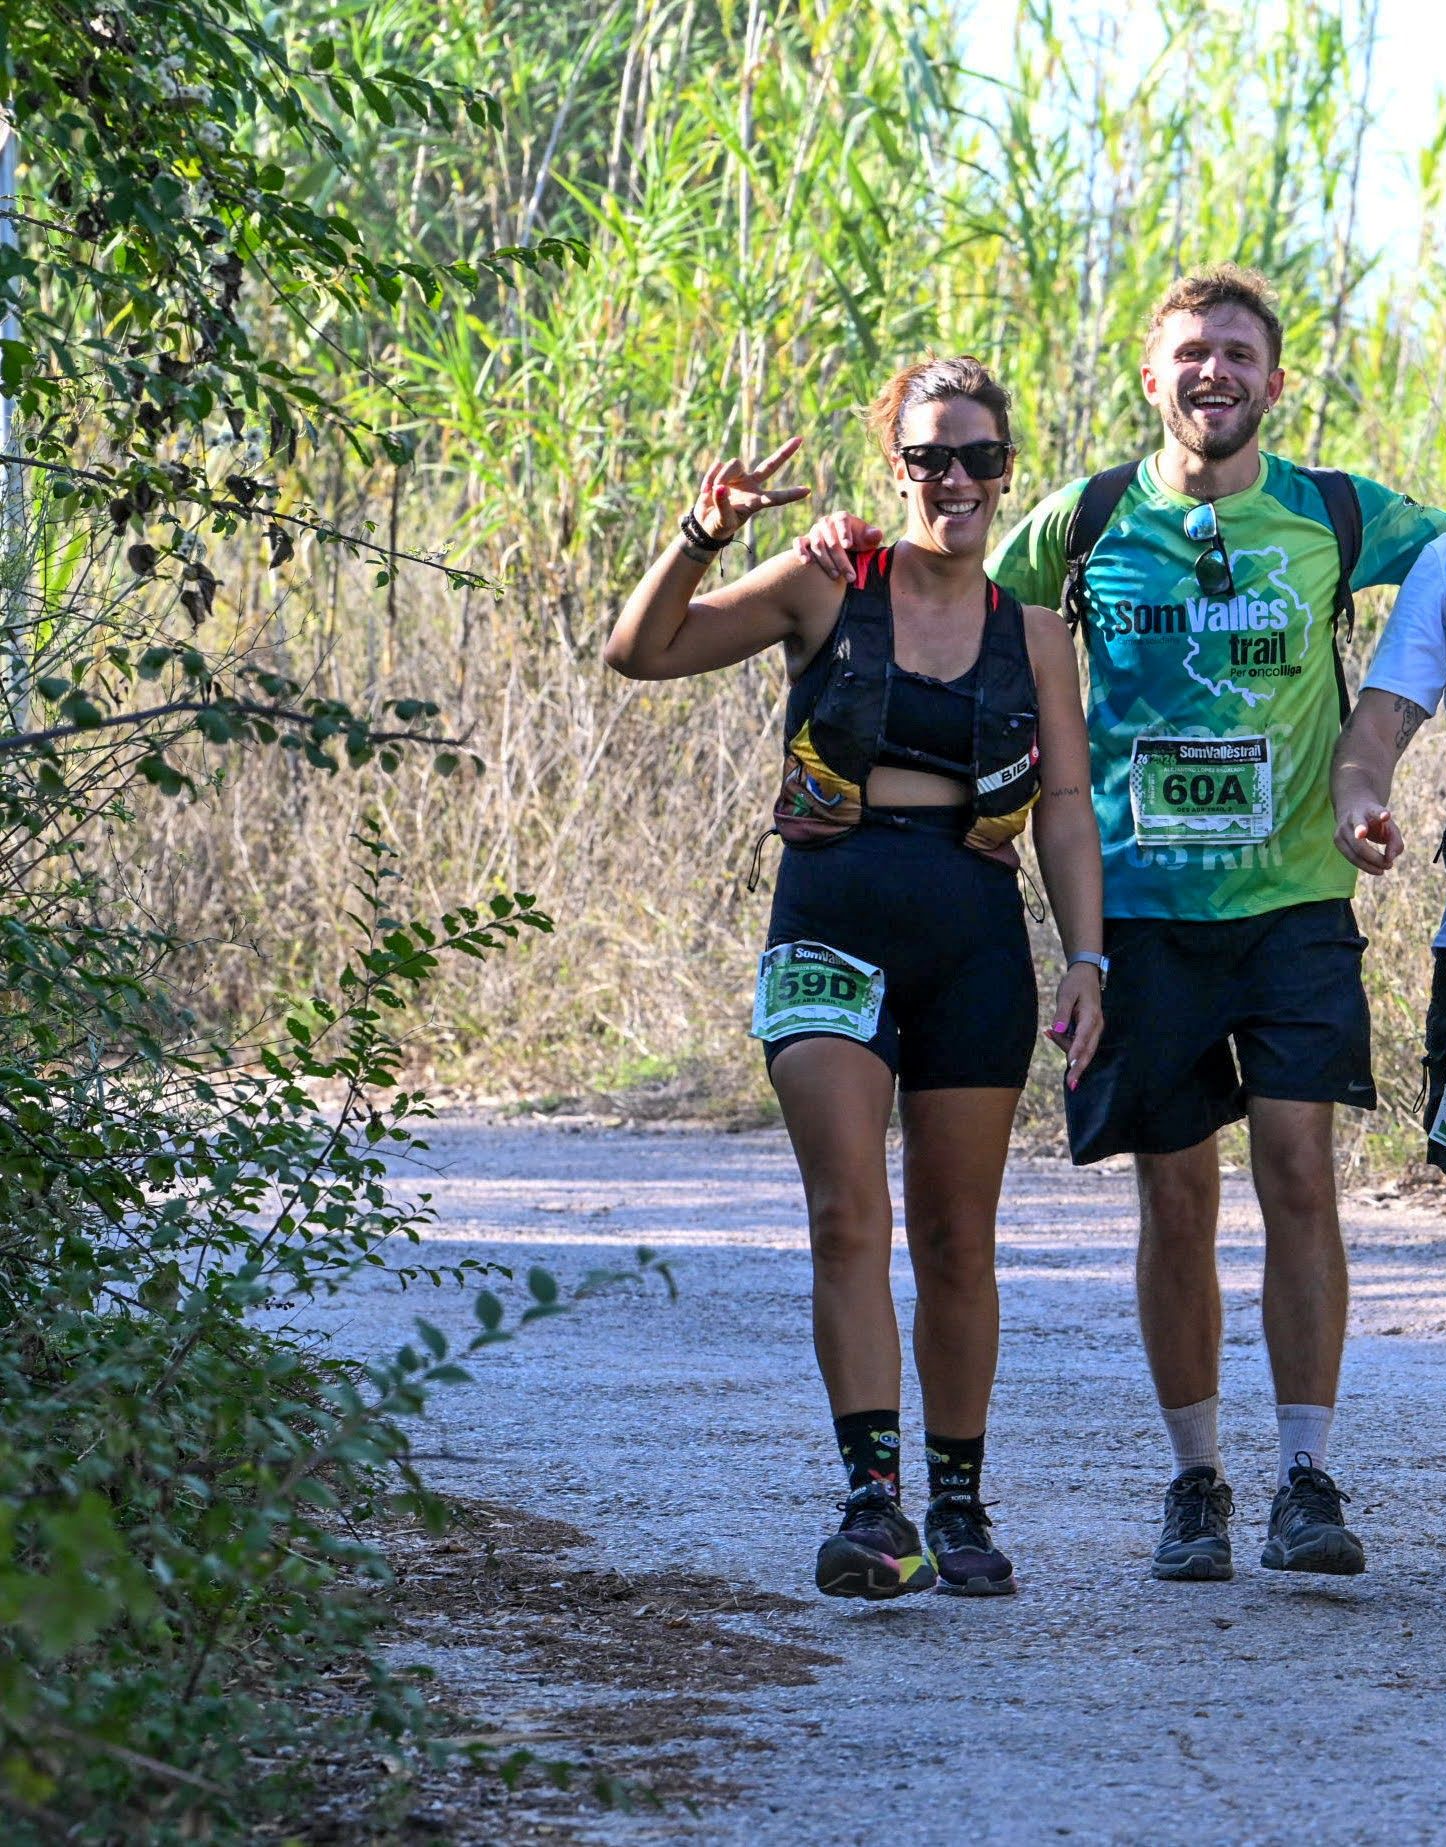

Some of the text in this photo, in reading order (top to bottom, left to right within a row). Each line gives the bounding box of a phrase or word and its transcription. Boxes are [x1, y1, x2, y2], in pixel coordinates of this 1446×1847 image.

[1229, 632, 1287, 666] trail
[1248, 665, 1302, 677] oncolliga
[1162, 774, 1248, 806] 60A
[778, 971, 858, 1001] 59D
